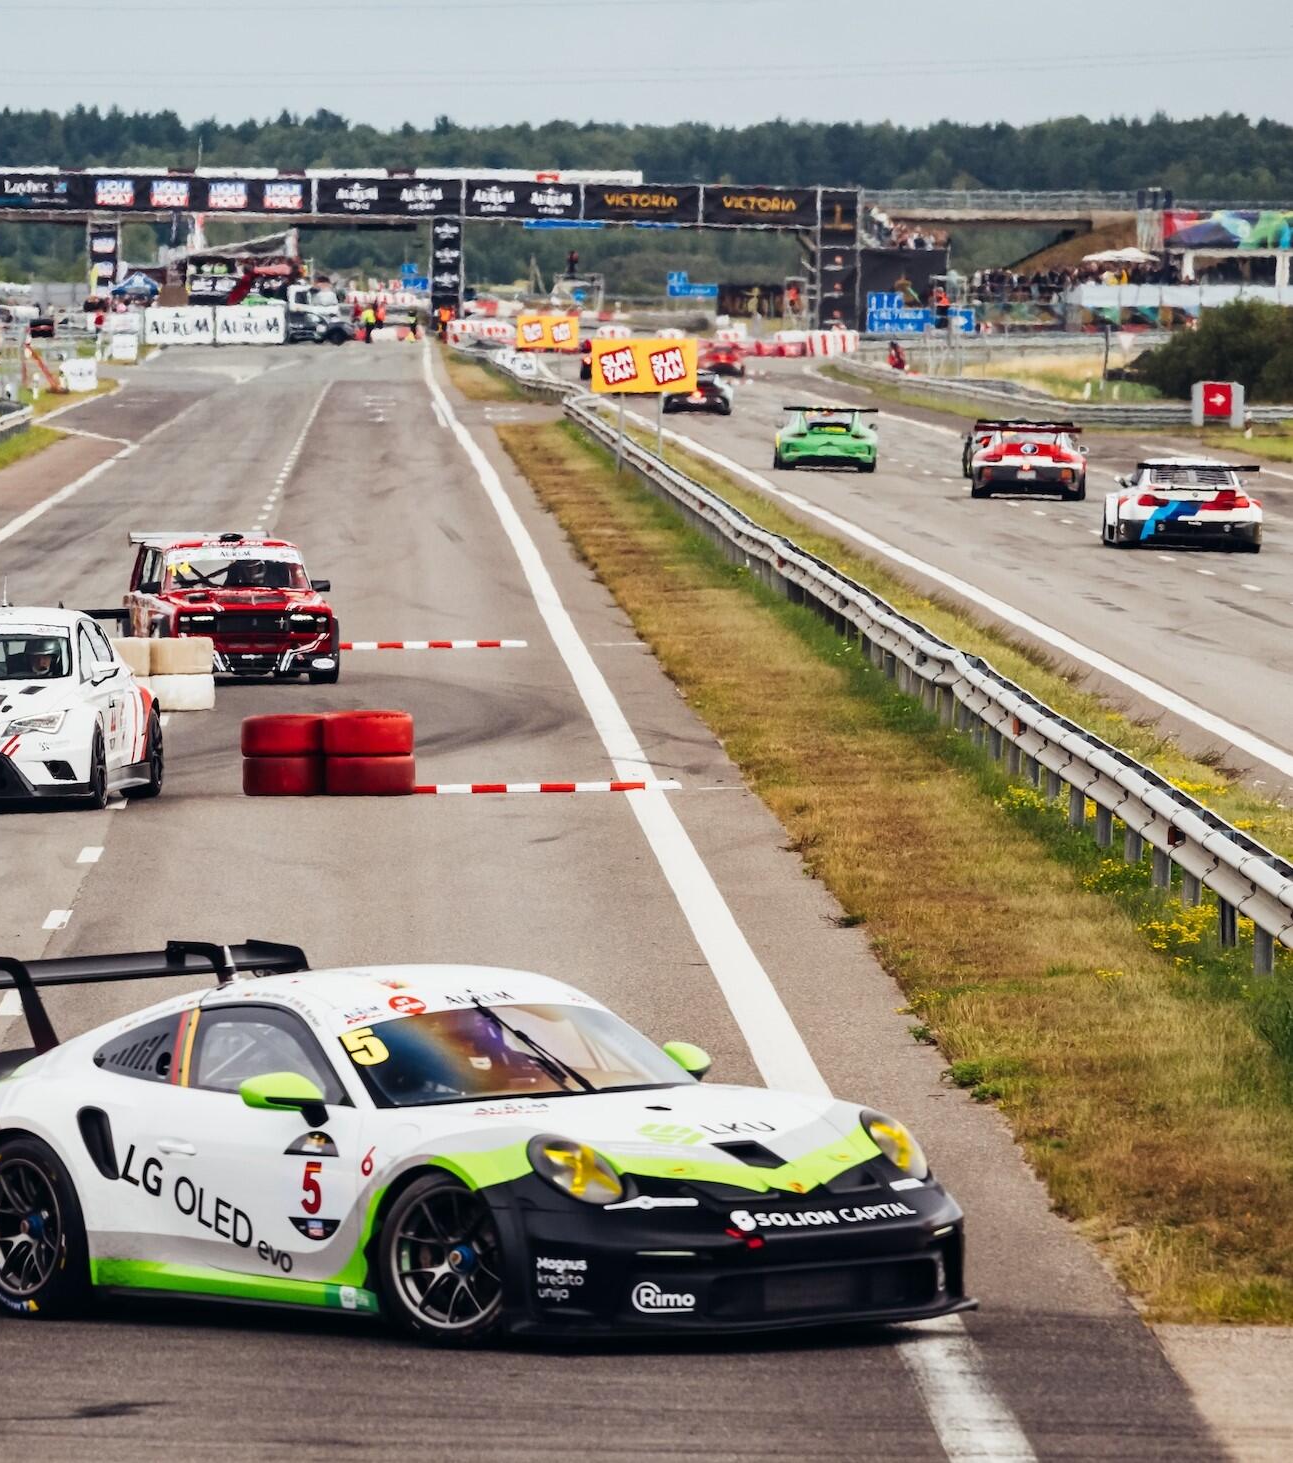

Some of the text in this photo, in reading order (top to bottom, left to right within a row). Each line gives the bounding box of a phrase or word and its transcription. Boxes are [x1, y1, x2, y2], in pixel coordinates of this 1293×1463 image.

[604, 193, 678, 209] VICTORIA
[722, 195, 798, 212] VICTORIA
[151, 318, 210, 336] AURUM
[220, 317, 280, 335] AURUM
[600, 349, 634, 367] SUN
[650, 348, 683, 367] SUN
[602, 363, 637, 384] VAN
[652, 362, 686, 384] VAN
[445, 990, 515, 1006] AURUM
[344, 1006, 379, 1019] AURUM
[340, 1027, 390, 1066] 5
[699, 1121, 777, 1136] LKU
[361, 1146, 376, 1176] 6
[301, 1161, 322, 1215] 5
[120, 1143, 293, 1274] LG OLED evo
[754, 1202, 918, 1228] SOLION CAPITAL
[536, 1257, 588, 1274] Magnus
[537, 1272, 585, 1287] kredito
[537, 1287, 570, 1303] unija
[639, 1286, 696, 1308] Rimo
